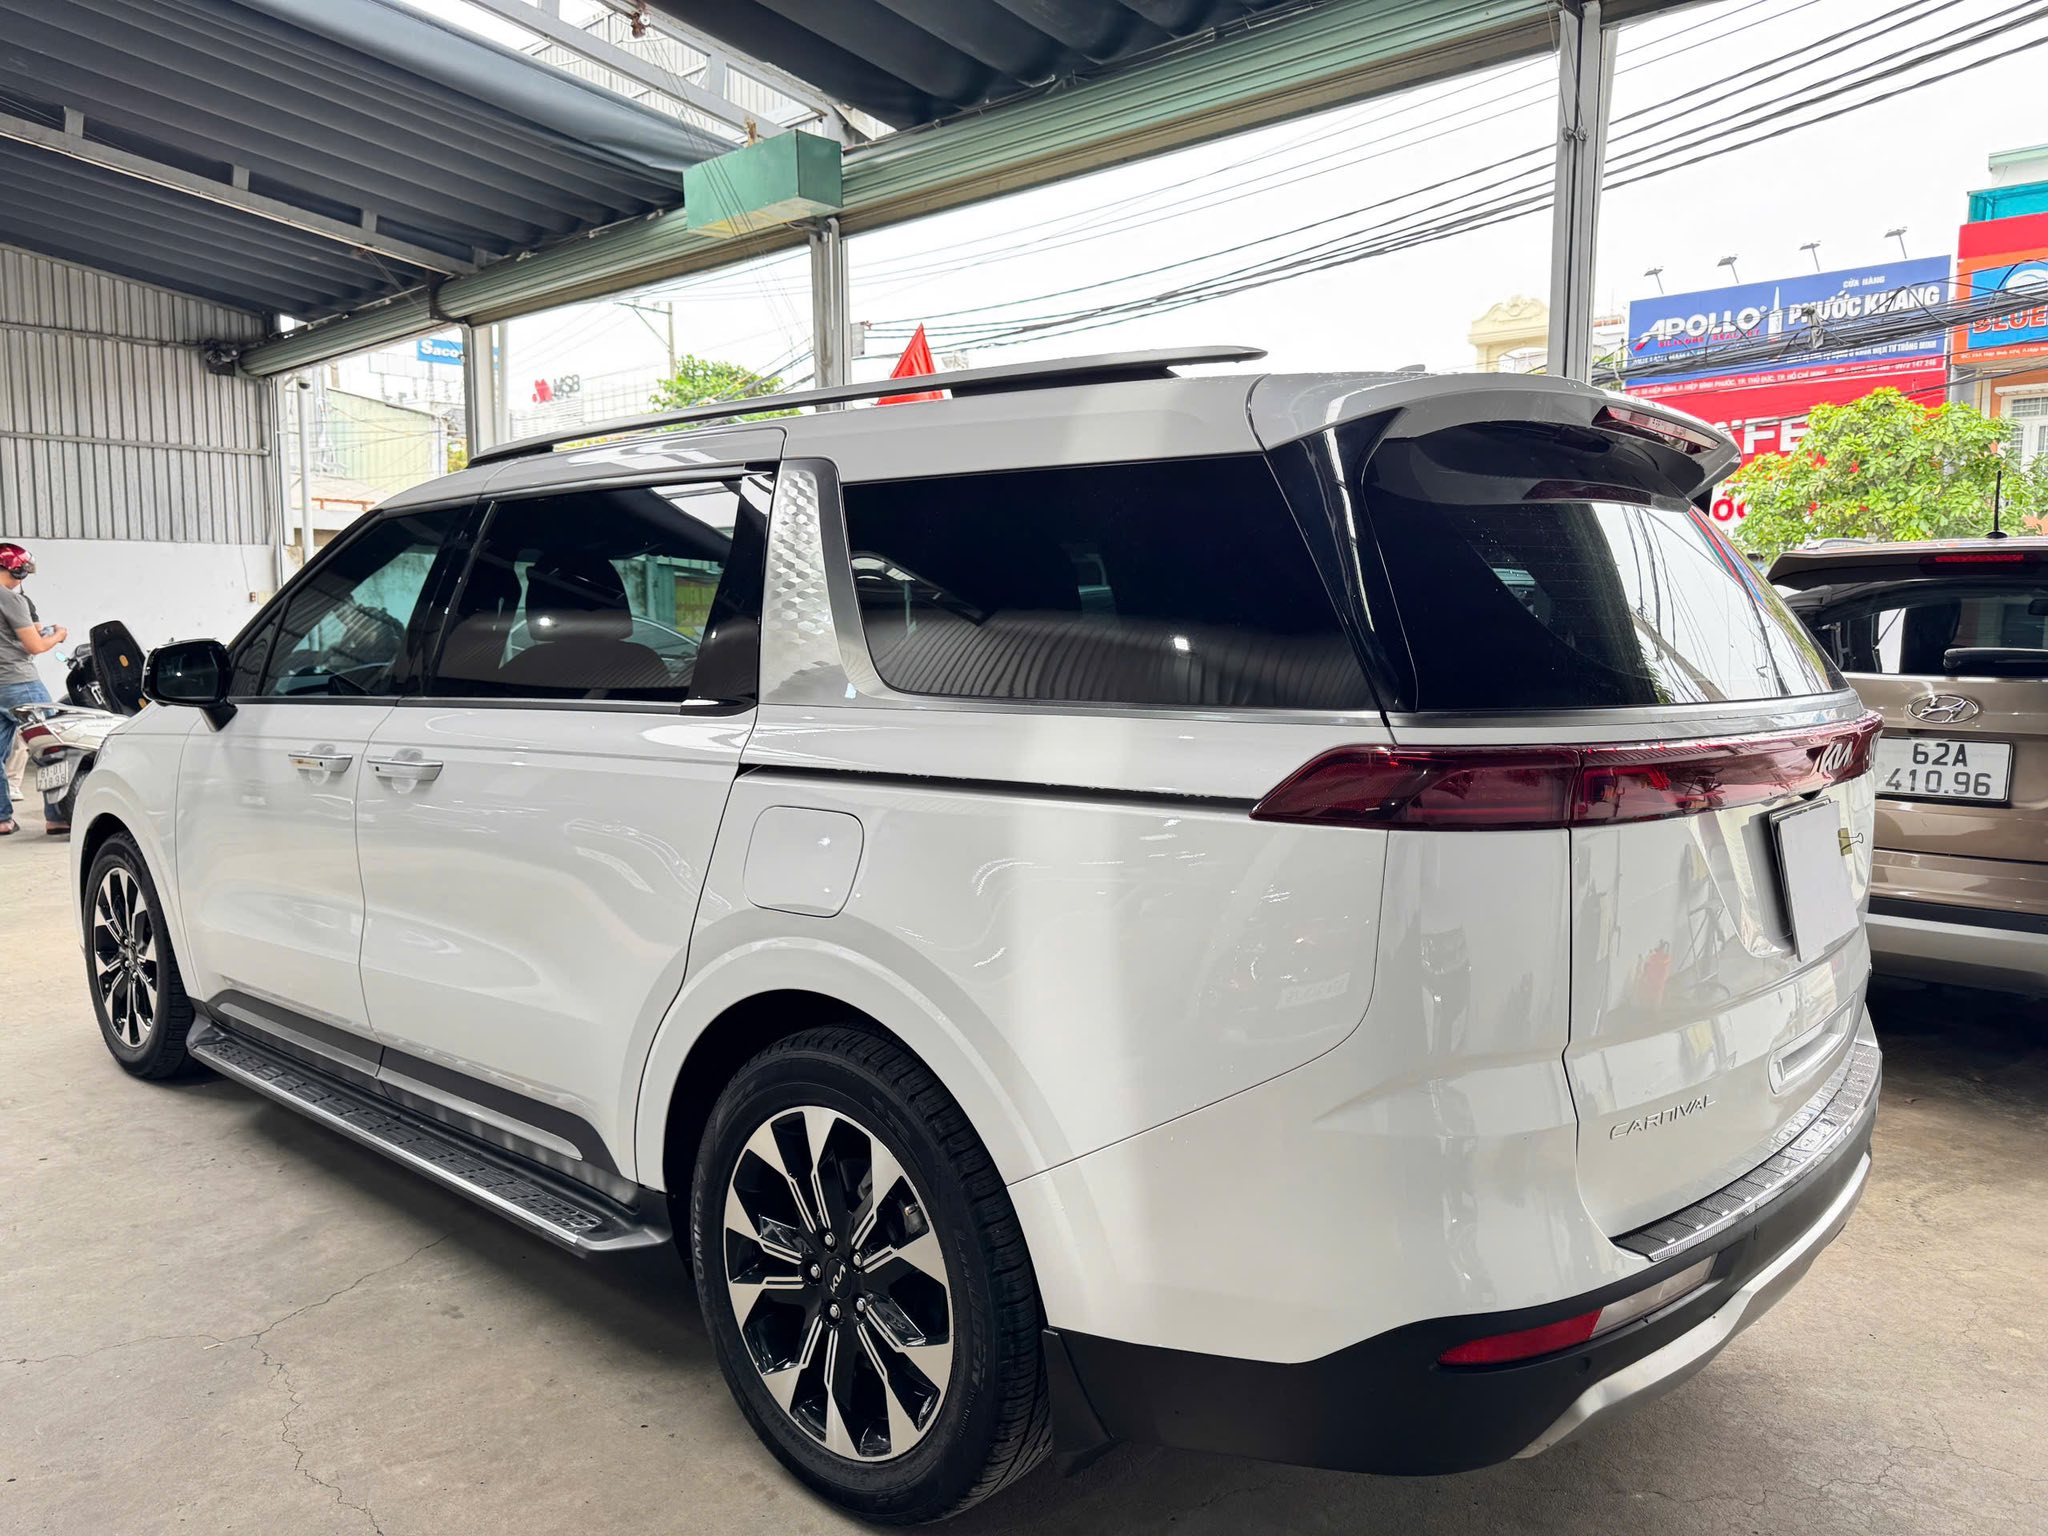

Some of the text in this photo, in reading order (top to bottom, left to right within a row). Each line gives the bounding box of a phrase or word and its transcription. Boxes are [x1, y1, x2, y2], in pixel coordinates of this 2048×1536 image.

[1864, 286, 1940, 315] KHANG
[1635, 307, 1761, 351] APOLLO
[1912, 742, 1968, 767] 62A
[1886, 767, 1992, 796] 410.96
[1609, 1094, 1717, 1140] CARNIVAL
